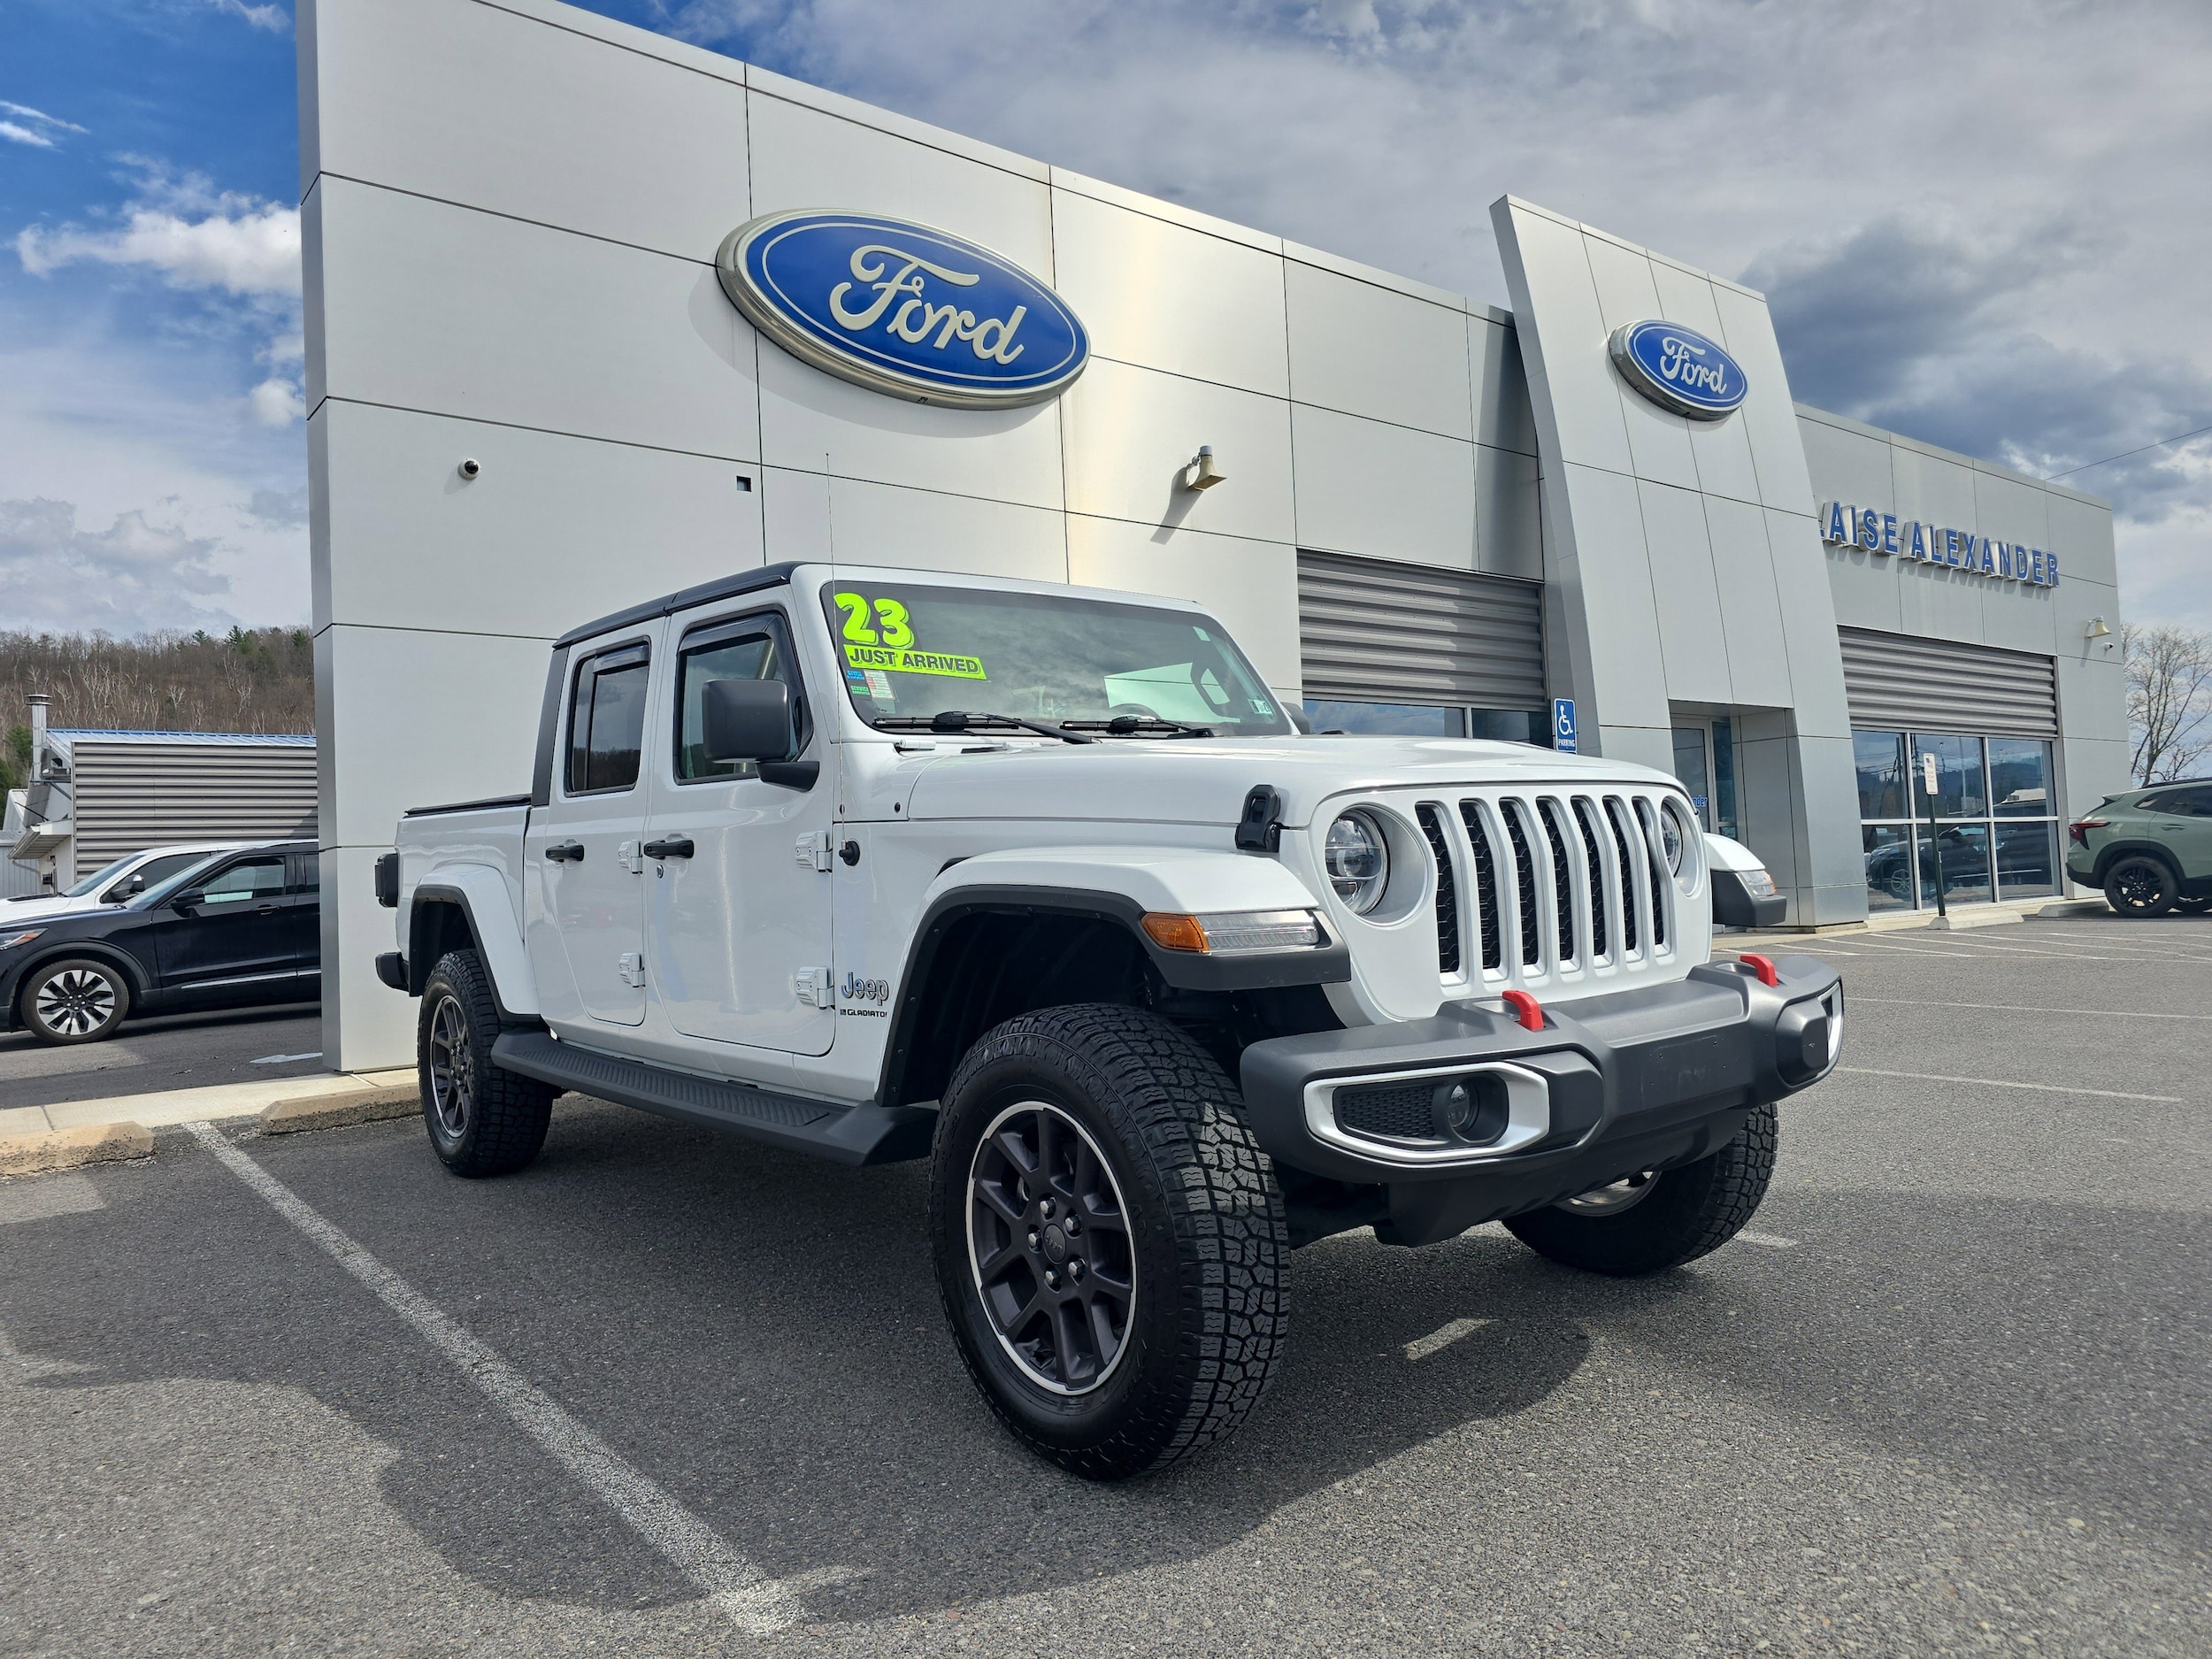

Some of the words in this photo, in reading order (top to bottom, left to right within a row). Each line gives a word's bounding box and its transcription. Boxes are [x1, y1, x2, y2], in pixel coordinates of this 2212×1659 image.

[829, 244, 1027, 365] Ford
[1660, 336, 1728, 395] Ford
[1820, 501, 1899, 555] AISE
[1909, 519, 2061, 588] ALEXANDER
[833, 592, 915, 650] 23
[849, 648, 898, 666] JUST
[902, 652, 982, 675] ARRIVED
[1558, 738, 1576, 748] PARKING
[841, 972, 889, 1006] Jeep
